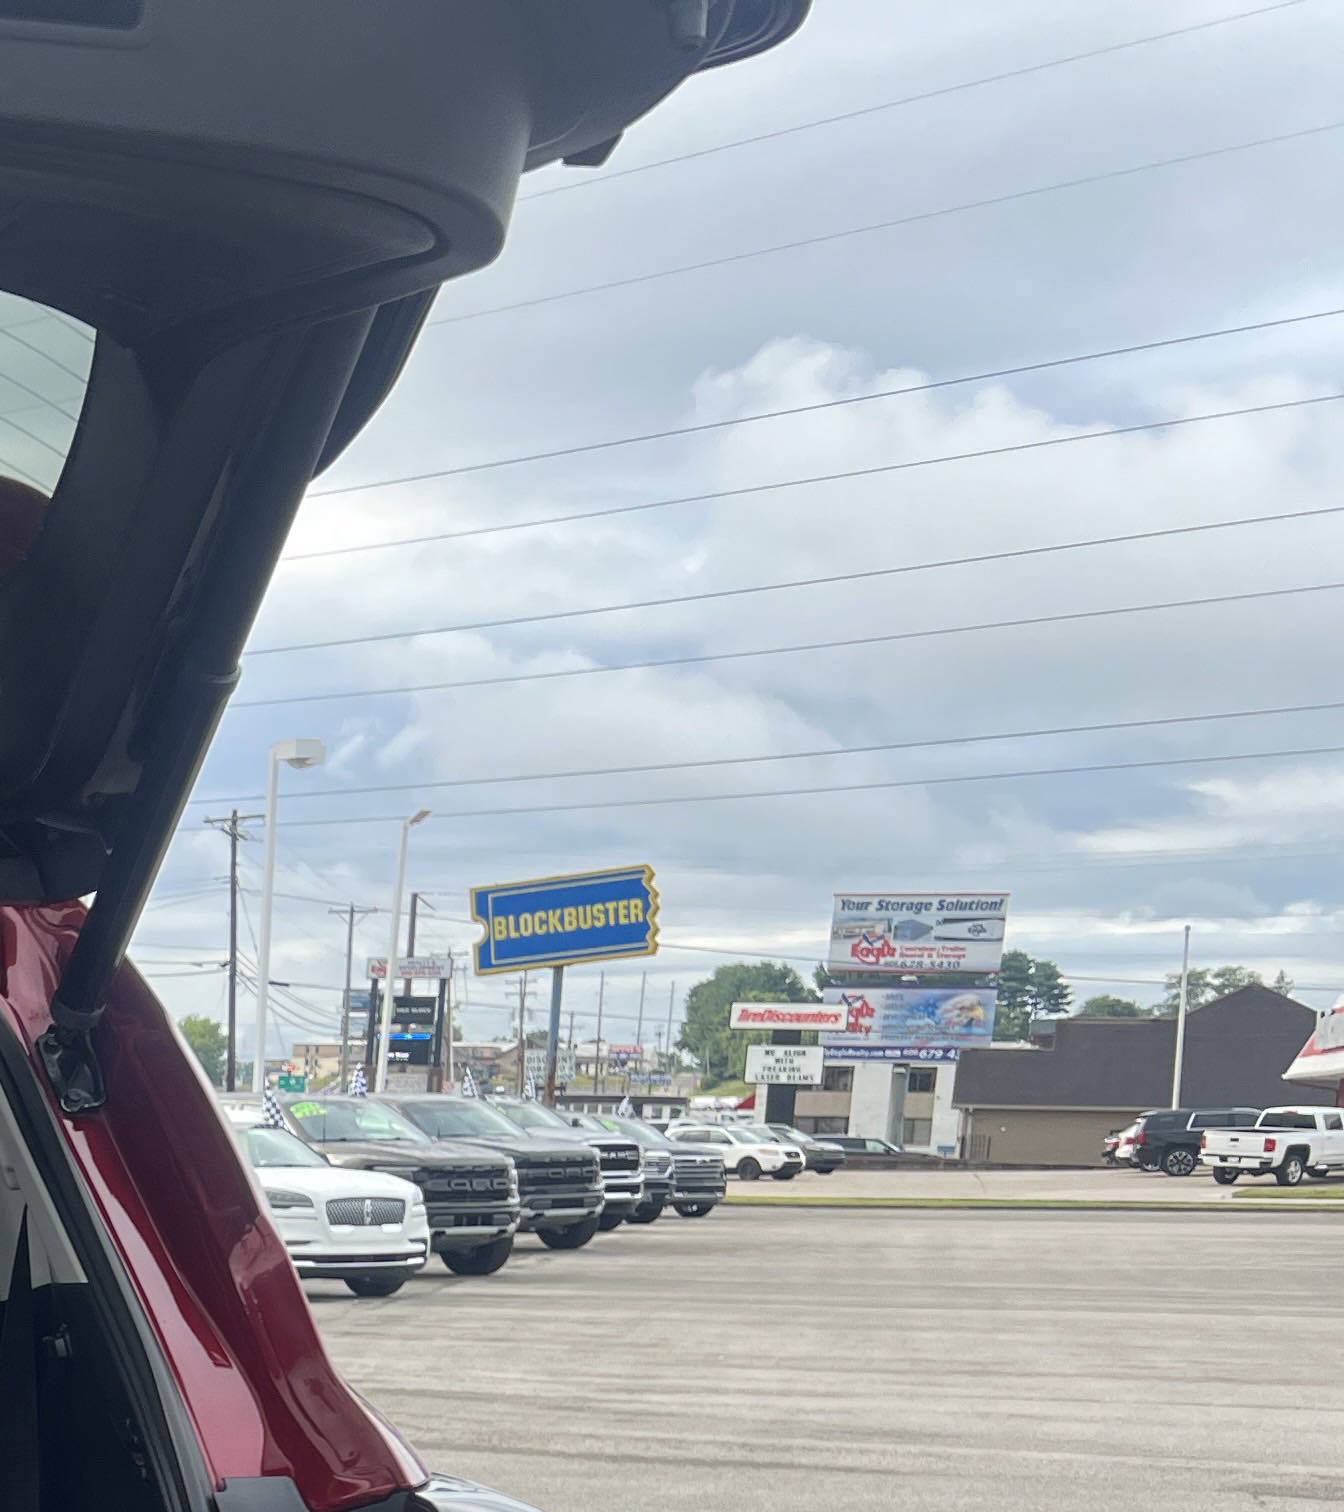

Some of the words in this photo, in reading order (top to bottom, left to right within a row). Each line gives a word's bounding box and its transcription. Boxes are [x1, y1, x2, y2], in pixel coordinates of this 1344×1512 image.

[494, 898, 644, 941] BLOCKBUSTER
[840, 899, 872, 911] Your
[876, 899, 933, 914] Storage
[936, 898, 1005, 911] Solution!
